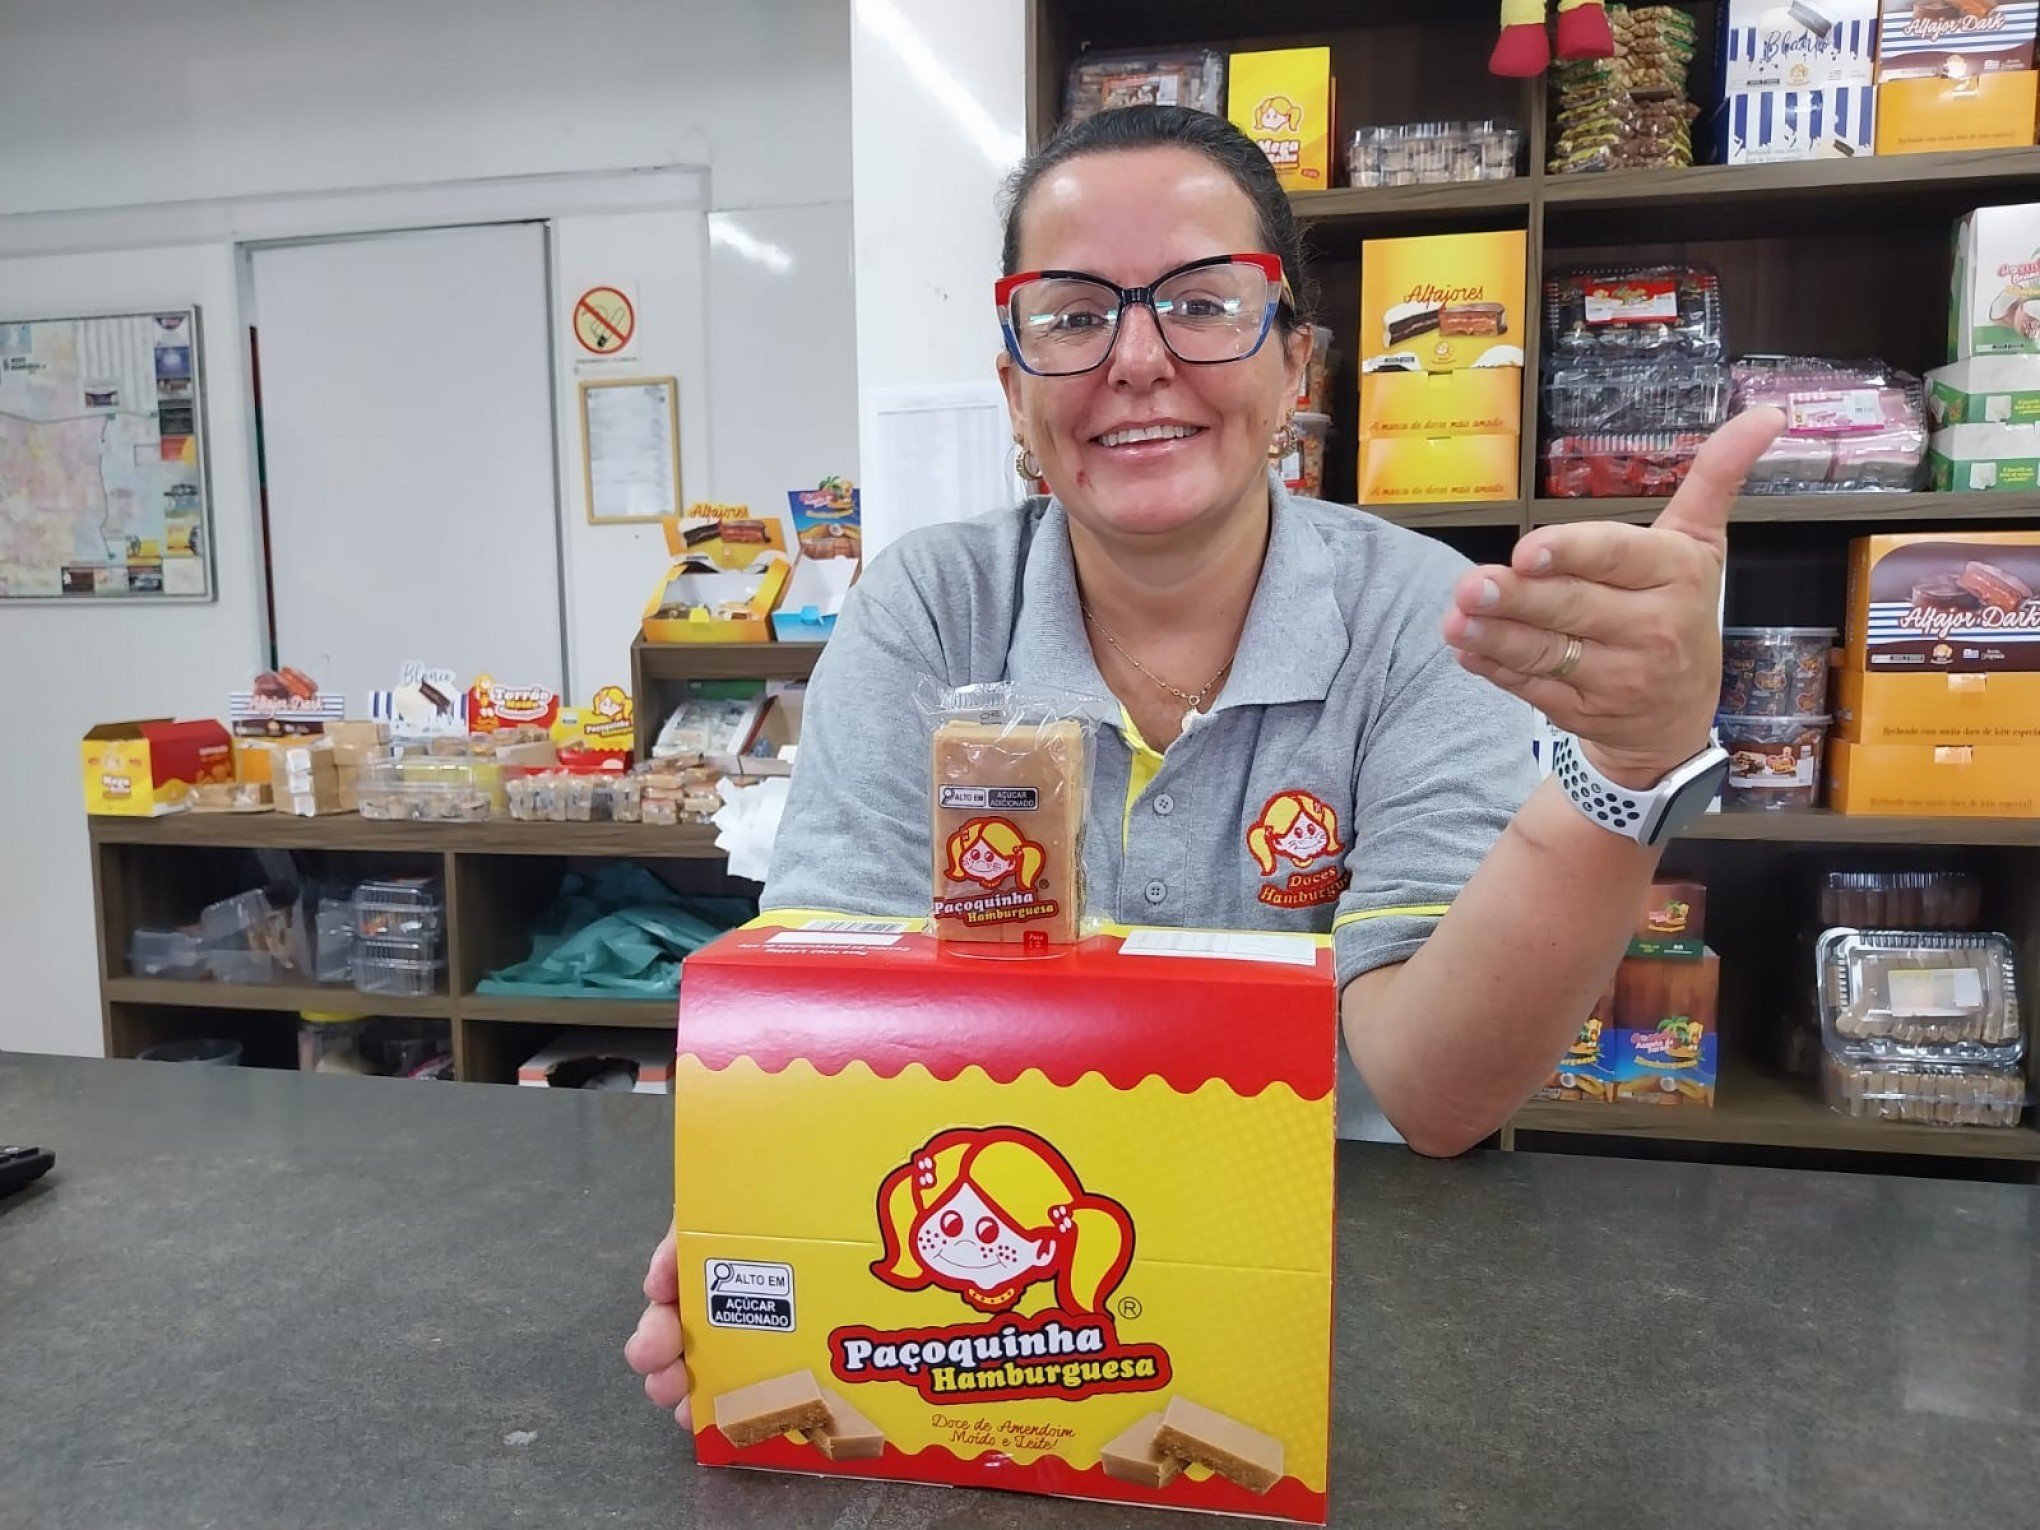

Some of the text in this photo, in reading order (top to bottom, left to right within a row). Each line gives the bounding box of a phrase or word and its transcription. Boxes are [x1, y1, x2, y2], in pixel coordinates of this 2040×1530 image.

[1904, 11, 2005, 41] Alfajor Dark
[1404, 284, 1484, 309] Alfajores
[1900, 606, 2040, 640] Alfajor Dark
[954, 793, 972, 801] ALTO
[1289, 866, 1337, 887] Doces
[934, 892, 1034, 915] Paçoquinha
[968, 904, 1054, 923] Hamburguesa
[735, 1273, 785, 1287] ALTO EM
[726, 1296, 776, 1312] AÇÚCAR
[715, 1311, 789, 1327] ADICIONADO
[844, 1323, 1103, 1372] Paçoquinha
[932, 1356, 1156, 1392] Hamburguesa
[931, 1413, 1076, 1437] Doce de Amendoim
[1001, 1437, 1012, 1447] e
